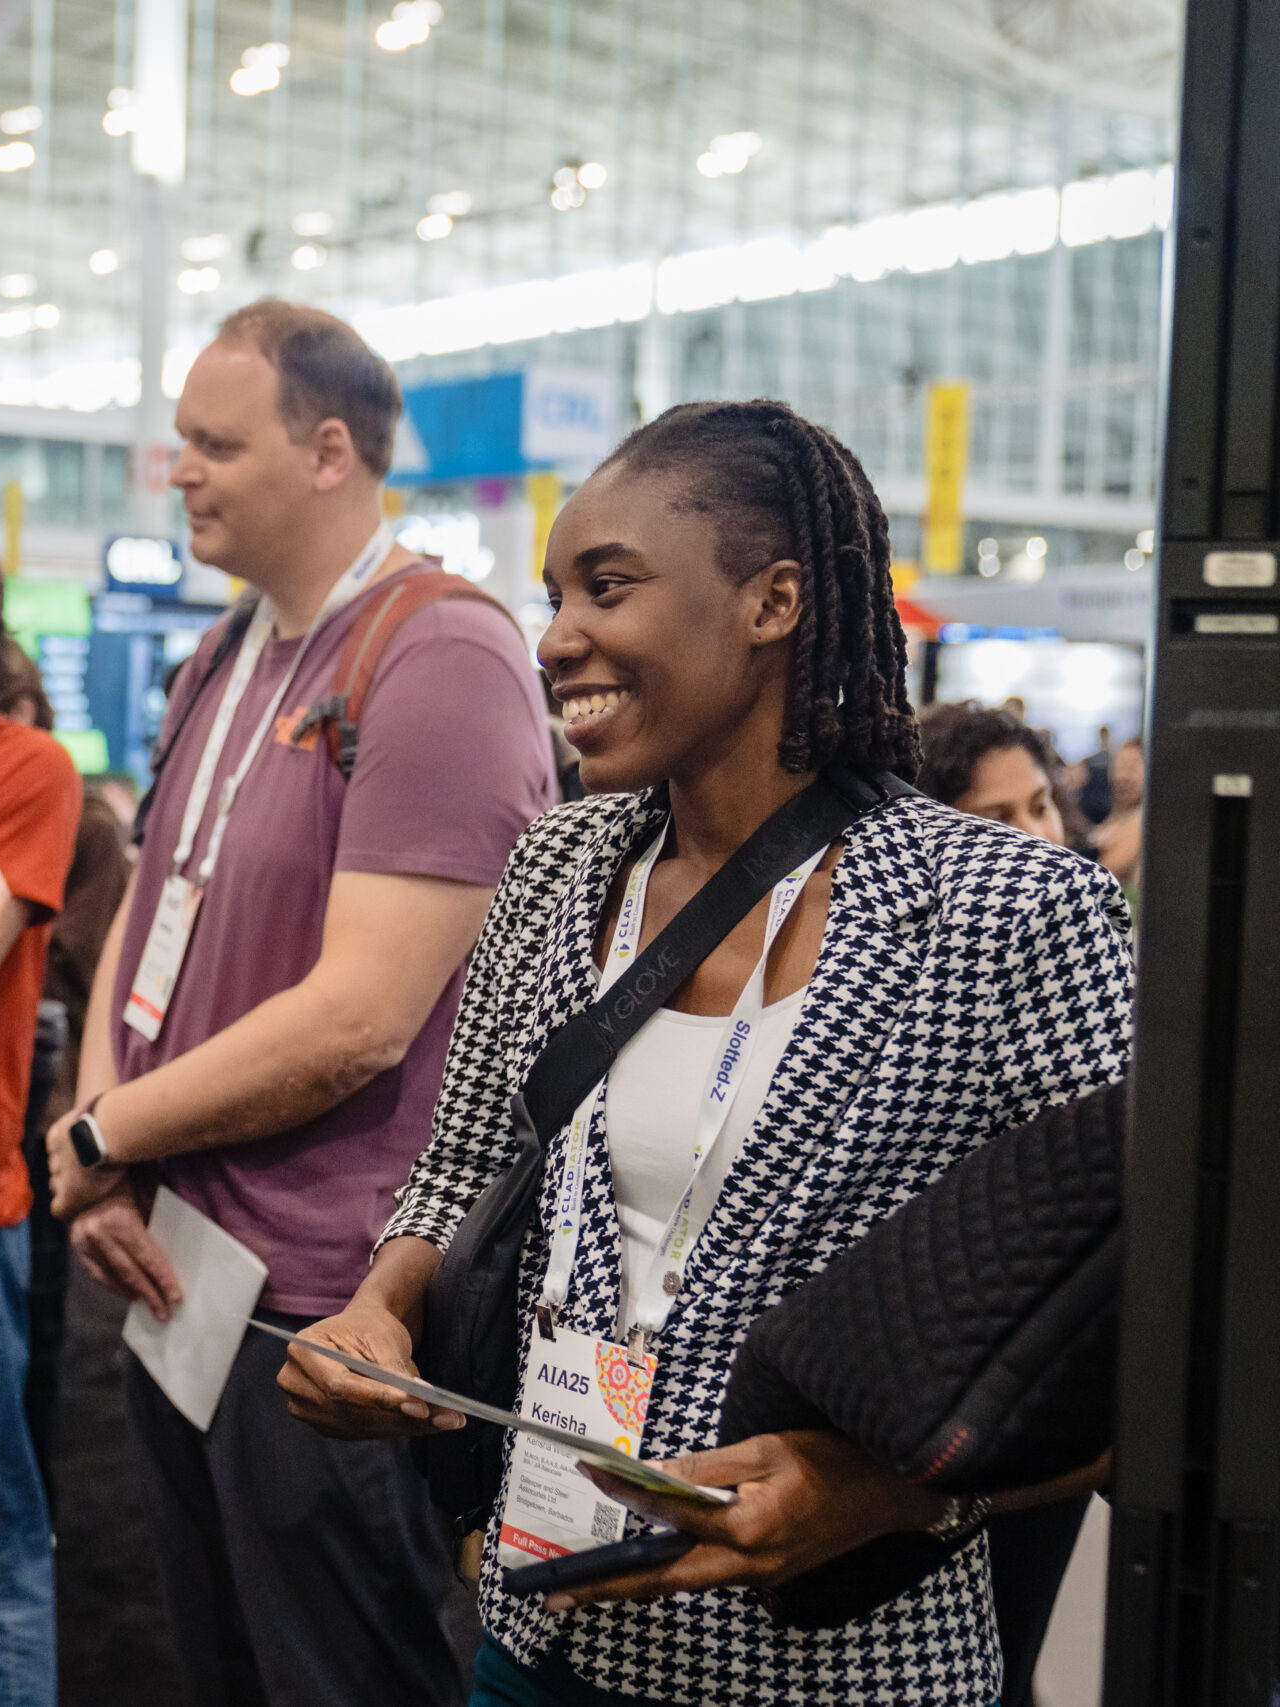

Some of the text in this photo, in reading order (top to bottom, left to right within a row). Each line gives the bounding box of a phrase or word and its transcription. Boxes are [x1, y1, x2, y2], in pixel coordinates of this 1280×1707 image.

[614, 945, 681, 1020] GLOVE
[710, 1020, 751, 1103] Slotted-Z
[561, 1121, 582, 1213] CLADIATOR
[537, 1363, 590, 1395] AIA25
[531, 1402, 587, 1436] Kerisha
[543, 1484, 554, 1493] and
[548, 1507, 574, 1523] Barbados
[512, 1532, 528, 1547] Full
[528, 1539, 548, 1556] Pass
